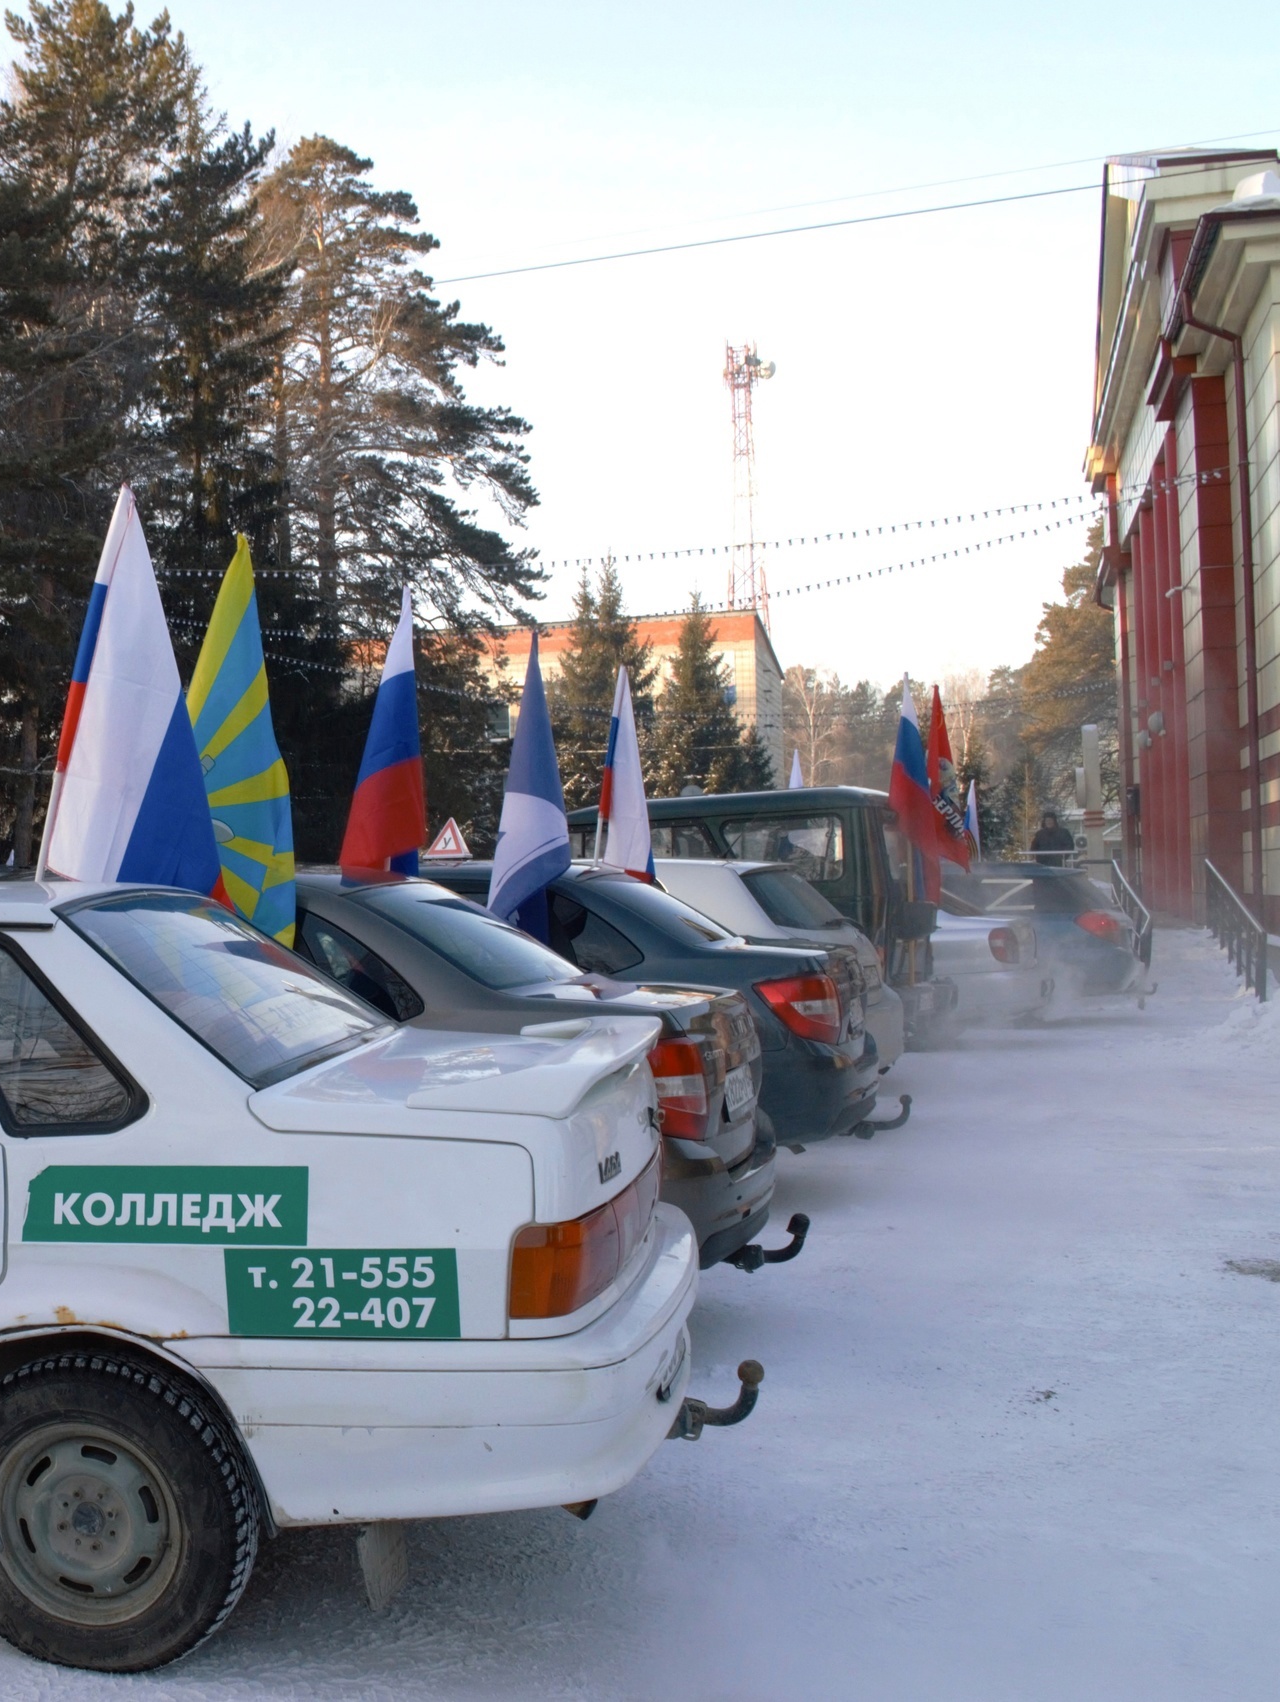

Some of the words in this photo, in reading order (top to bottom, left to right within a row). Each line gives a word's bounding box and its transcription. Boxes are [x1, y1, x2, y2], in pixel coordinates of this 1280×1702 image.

[932, 794, 965, 833] БЕРЛИ
[53, 1192, 283, 1233] КОЛЛЕДЖ
[291, 1256, 437, 1289] 21-555
[292, 1297, 437, 1329] 22-407
